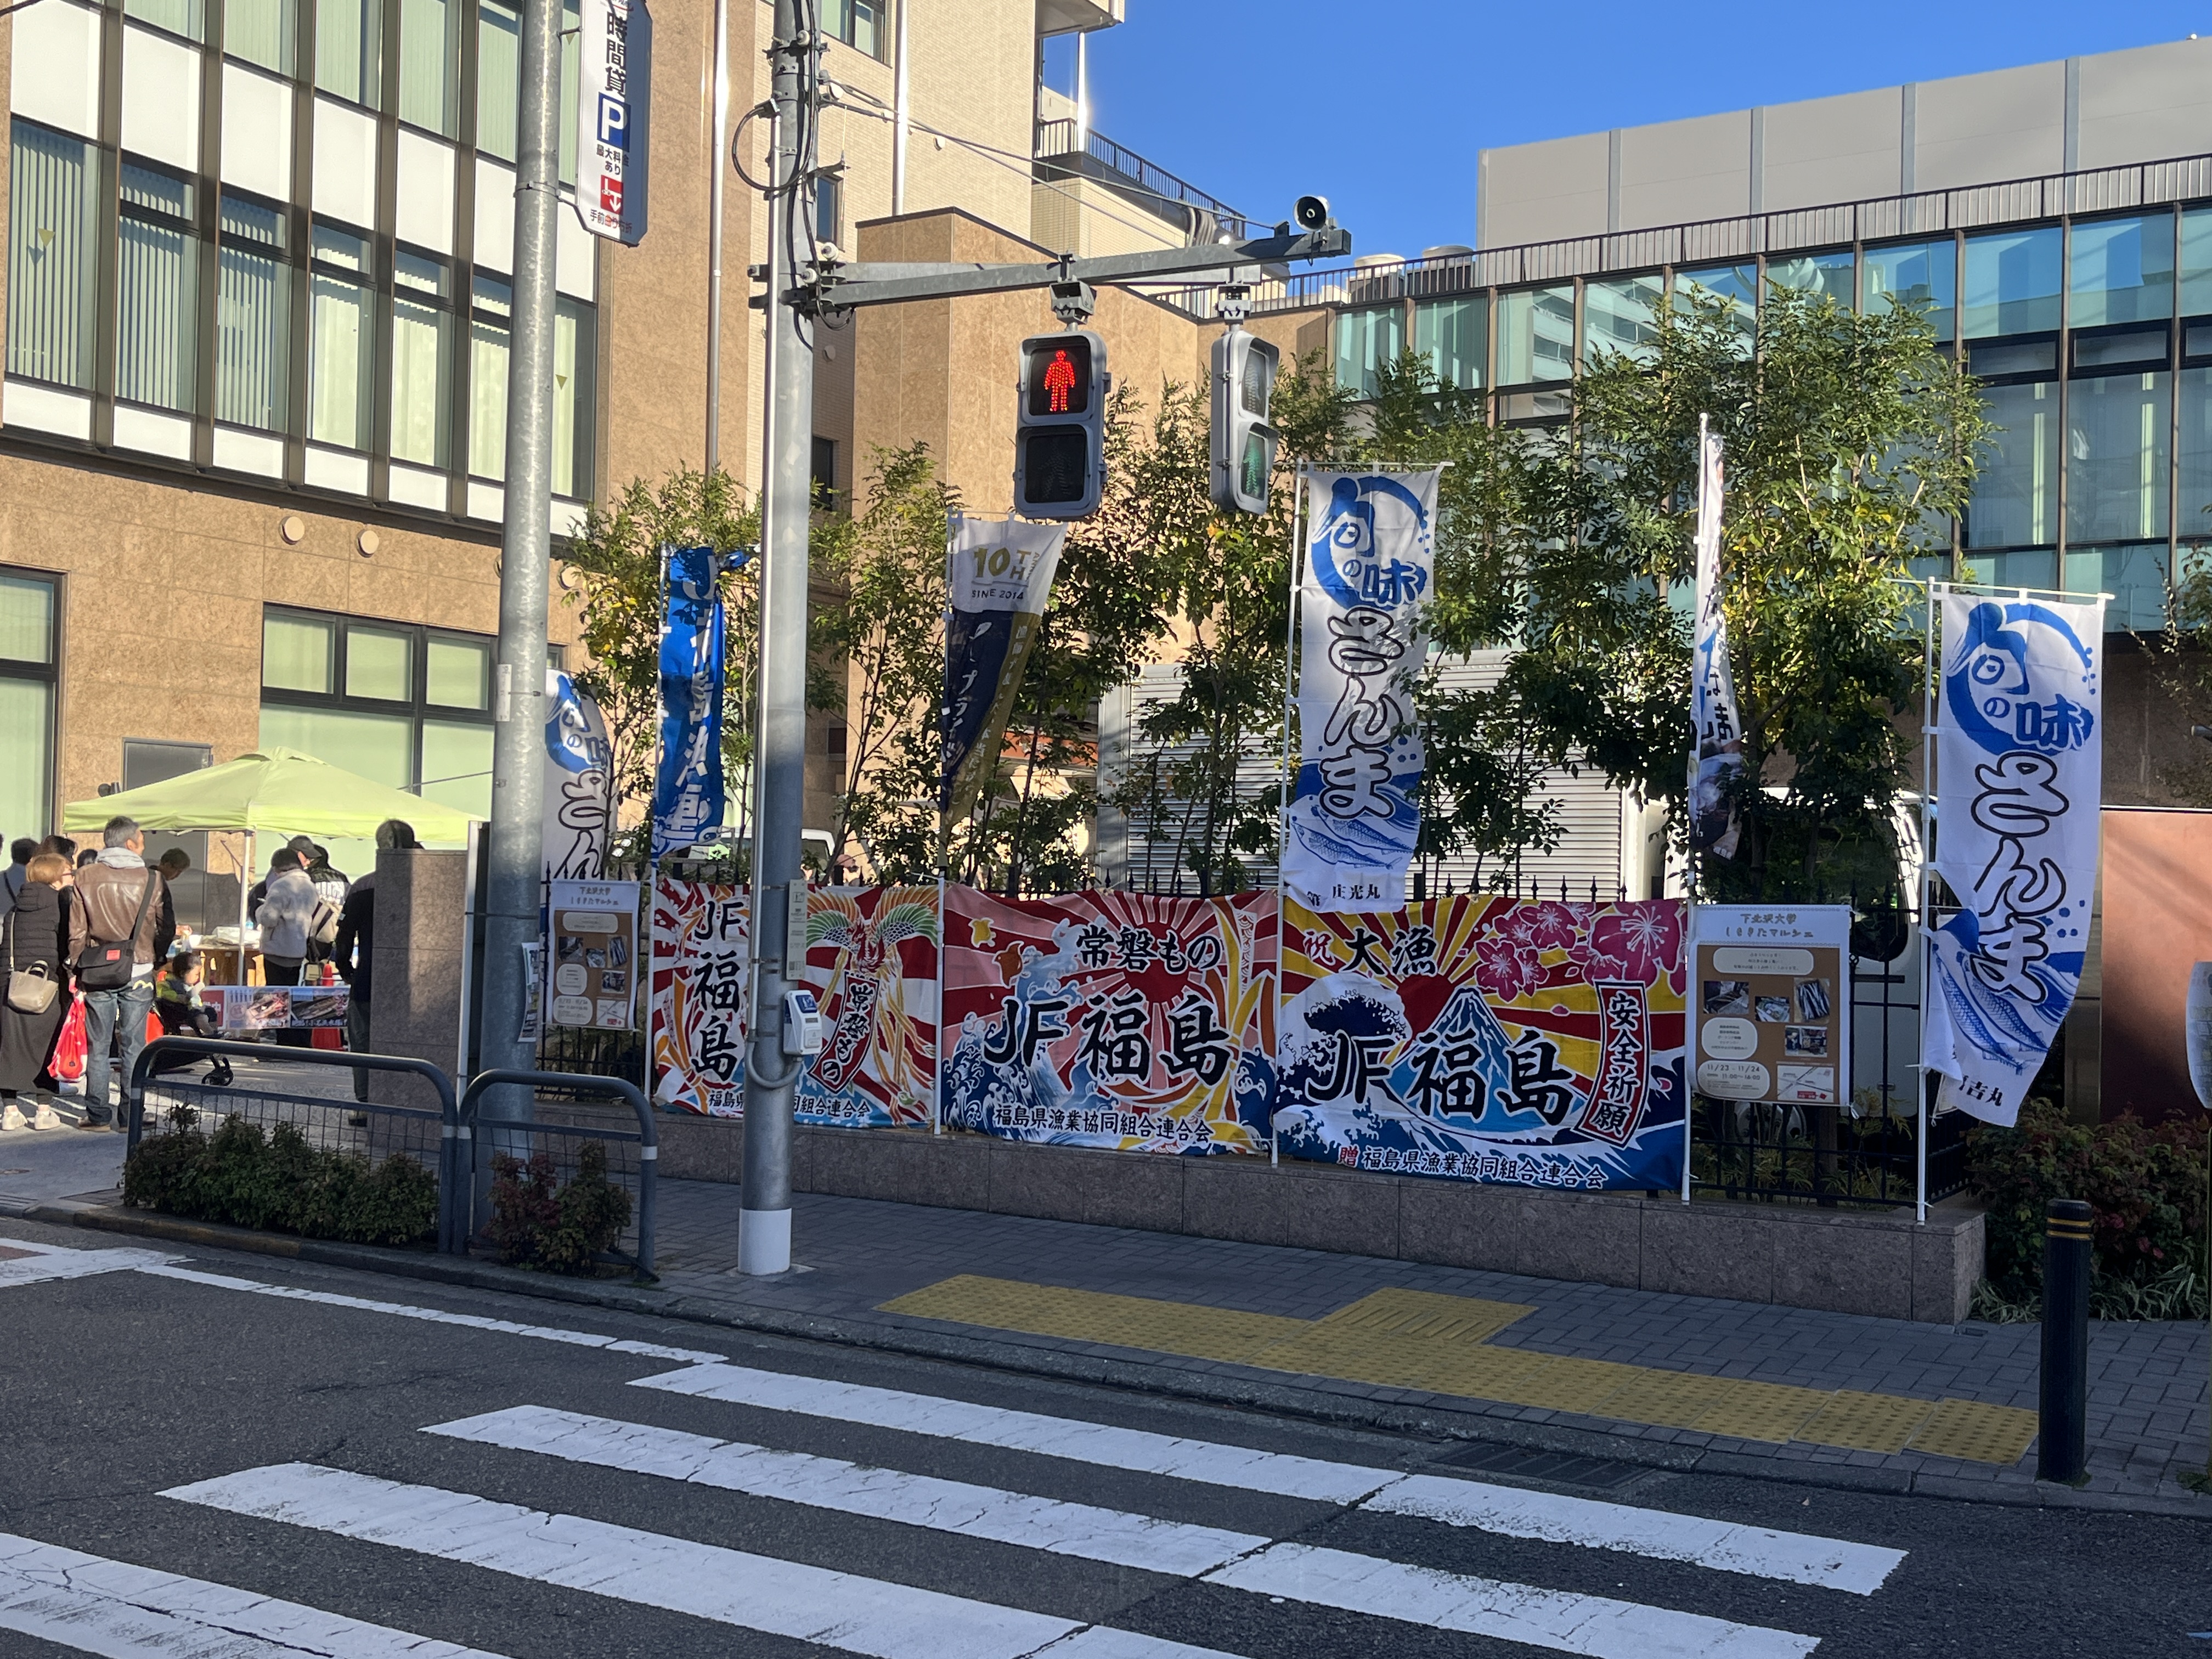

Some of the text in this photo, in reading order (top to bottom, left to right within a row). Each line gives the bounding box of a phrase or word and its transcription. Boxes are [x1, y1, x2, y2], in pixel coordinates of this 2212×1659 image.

[605, 11, 627, 98] 時間貸
[601, 98, 628, 140] P
[596, 144, 629, 167] 最大料金
[605, 160, 620, 175] あり
[999, 590, 1024, 600] 2014
[1319, 606, 1404, 819] さんま
[1332, 884, 1380, 900] 庄光丸
[1971, 751, 2069, 1005] さんま
[1076, 925, 1221, 972] 常磐もの
[1340, 927, 1437, 975] 大漁
[823, 984, 873, 1082] 常磐もの
[984, 993, 1232, 1085] JF福島
[1307, 1029, 1575, 1126] JF福島
[1591, 994, 1643, 1137] 安全祈願
[995, 1108, 1214, 1144] 福島県漁業協同組合連合会
[1363, 1147, 1607, 1190] 福島県漁業協同組合連合会
